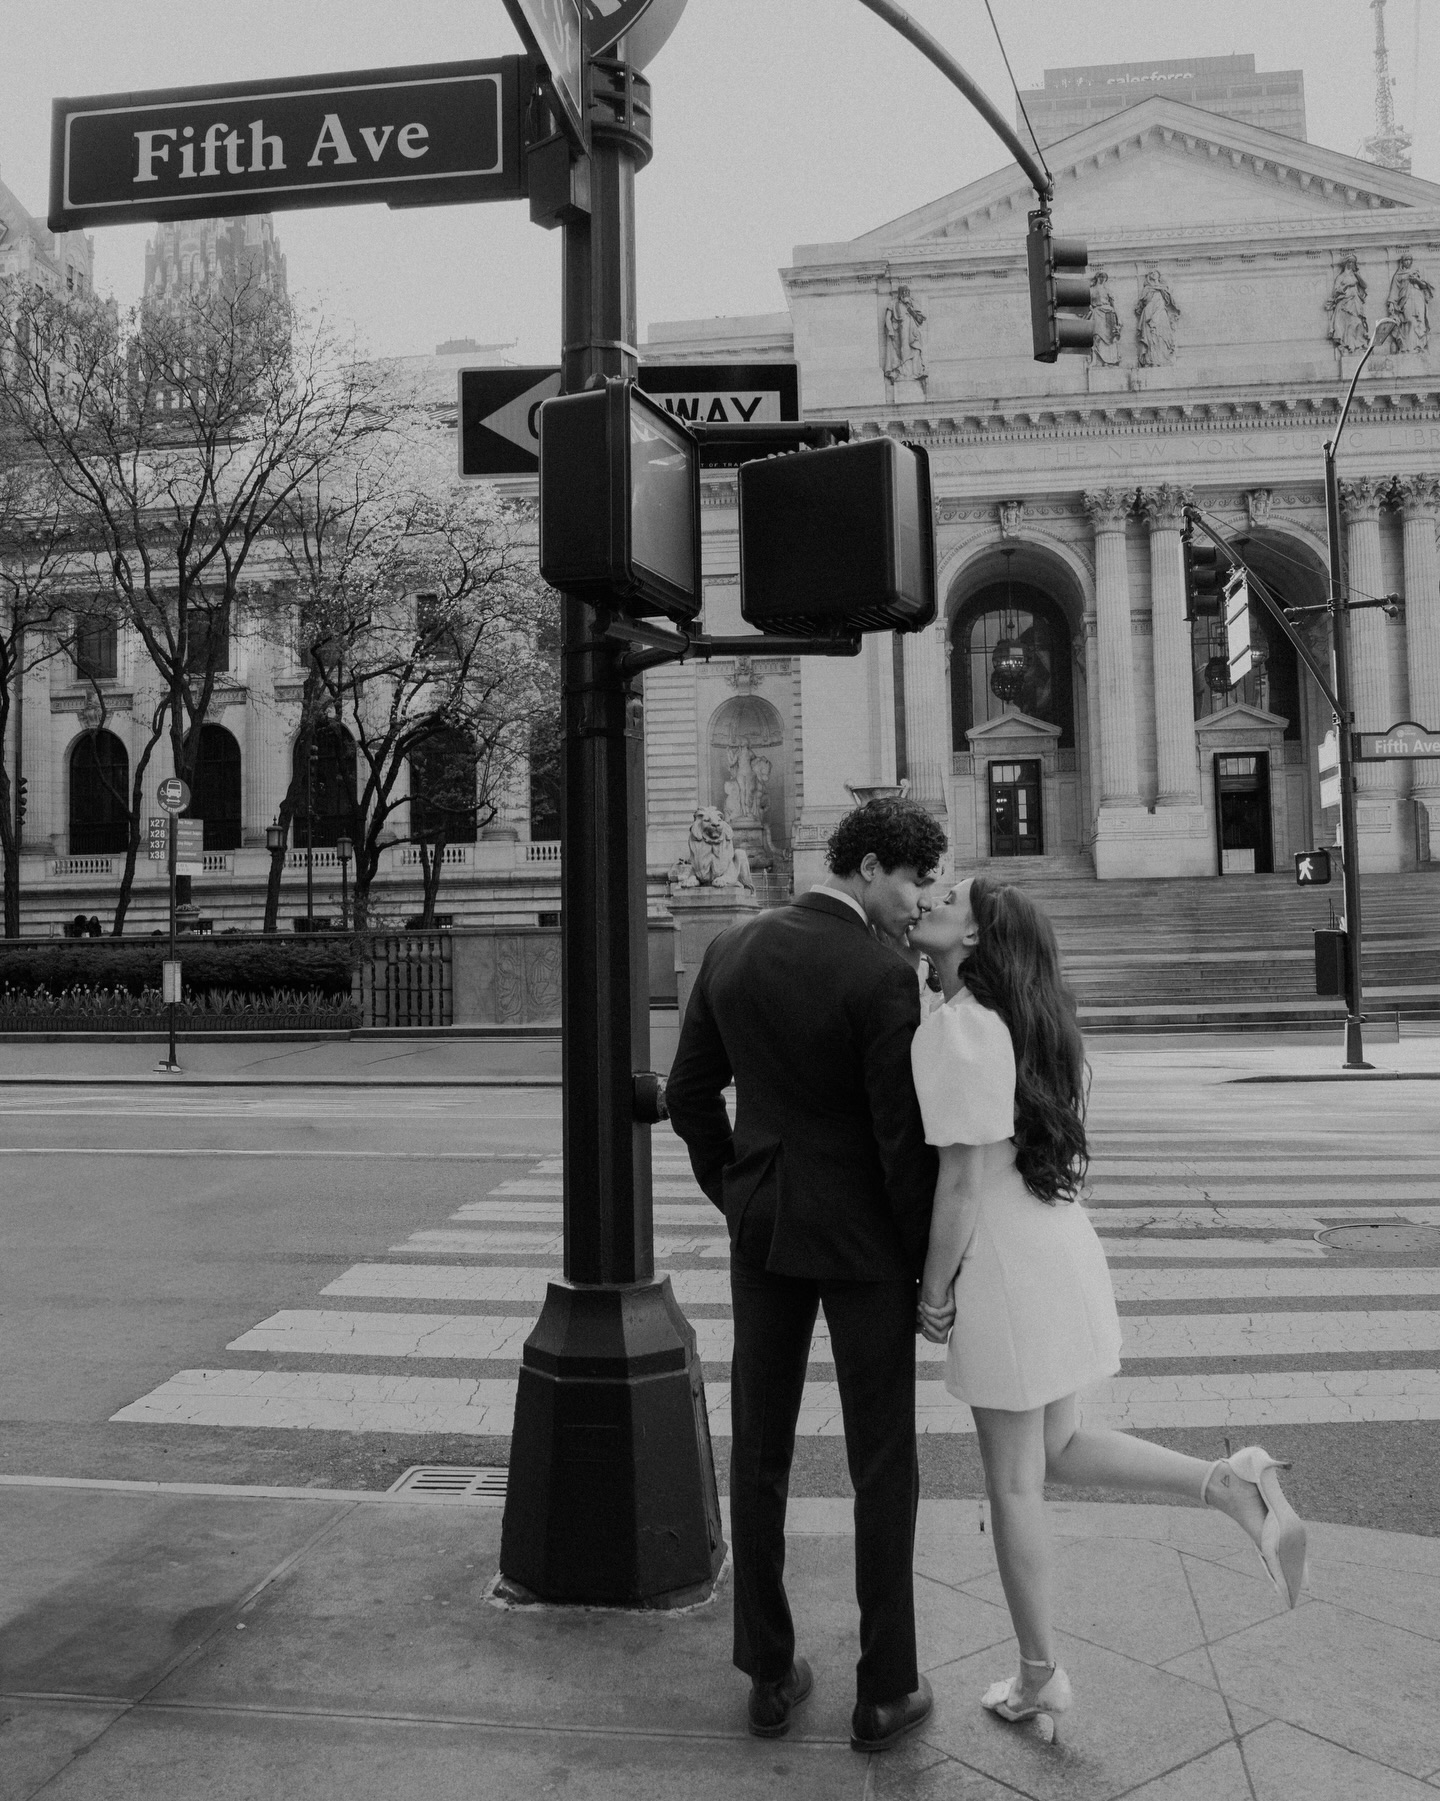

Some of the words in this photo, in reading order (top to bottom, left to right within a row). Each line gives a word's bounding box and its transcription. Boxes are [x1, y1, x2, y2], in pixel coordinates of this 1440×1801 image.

[1106, 70, 1194, 85] salesforce
[133, 119, 287, 183] Fifth
[307, 113, 430, 167] Ave
[1037, 445, 1088, 464] THE
[1107, 442, 1169, 460] NEW
[1191, 437, 1255, 456] YORK
[1277, 431, 1364, 452] PUBIC
[1388, 428, 1440, 447] LIBR
[1375, 739, 1408, 754] Fifth
[1413, 739, 1440, 753] Ave
